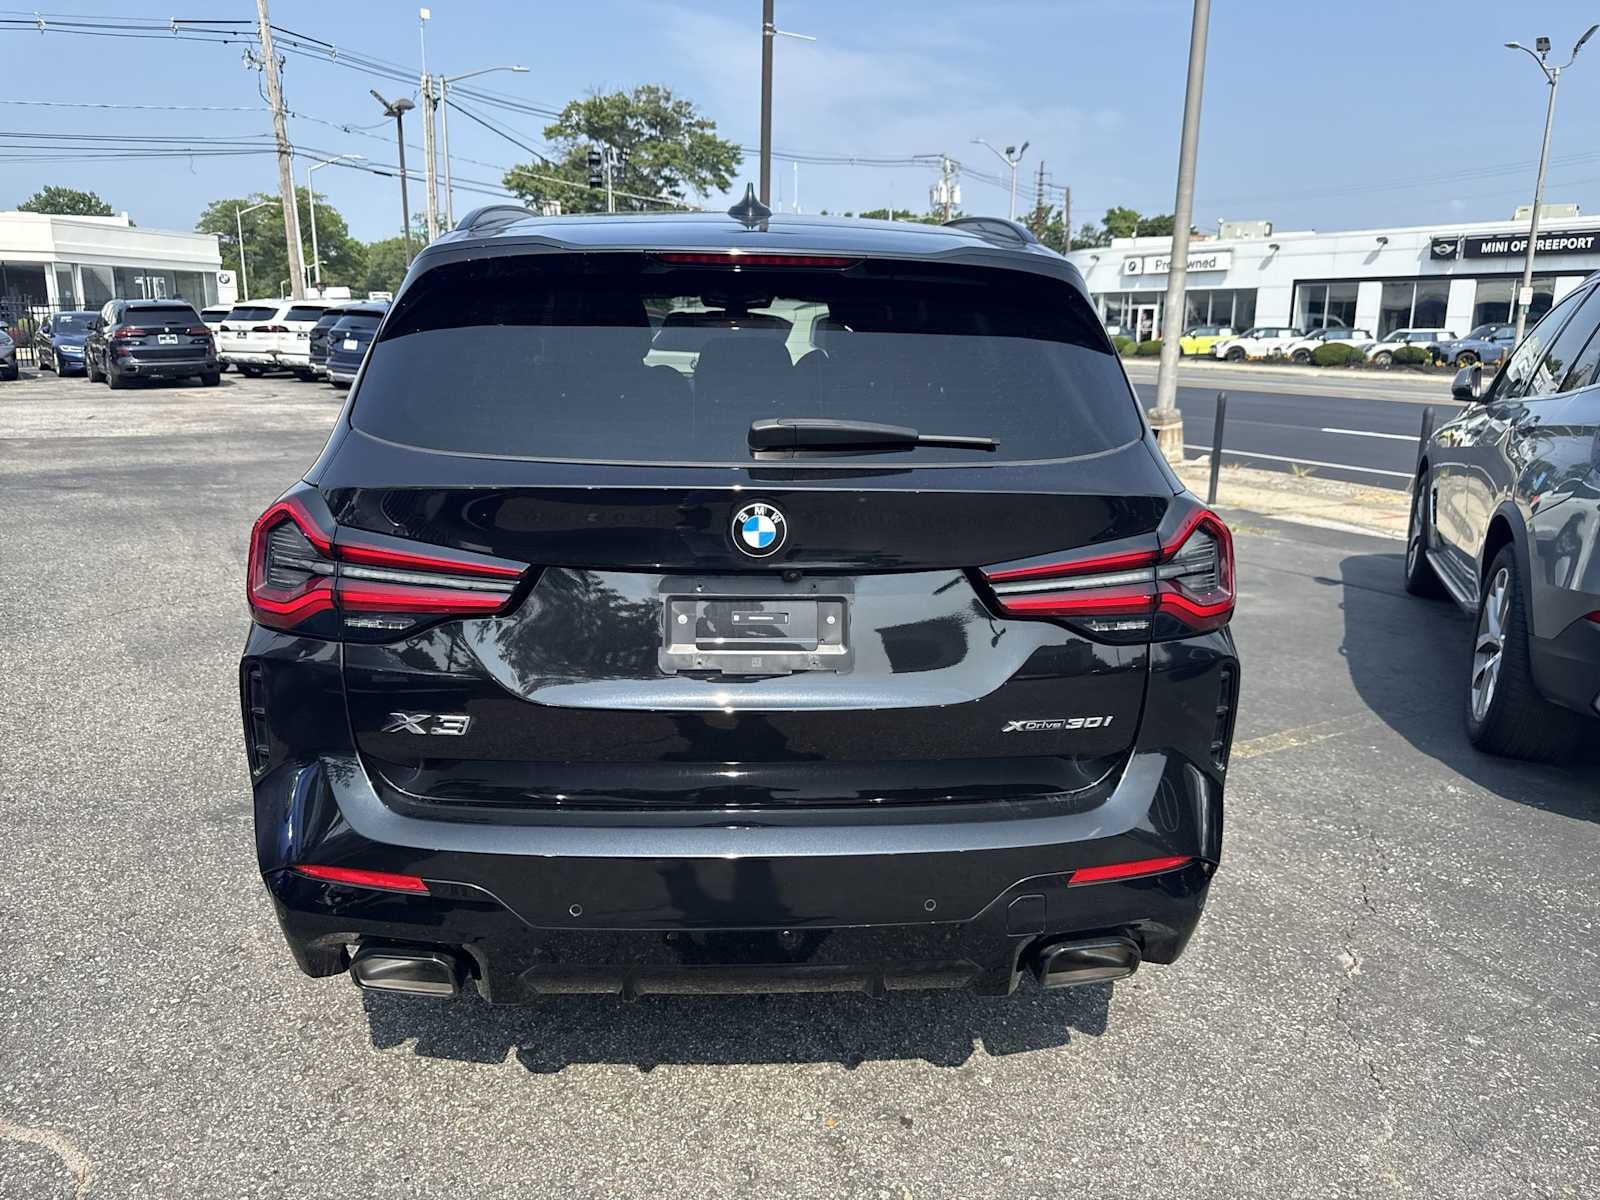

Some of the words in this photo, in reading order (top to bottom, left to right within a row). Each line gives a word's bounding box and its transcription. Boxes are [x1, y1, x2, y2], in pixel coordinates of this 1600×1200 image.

[1481, 241, 1508, 253] MINI
[1511, 240, 1528, 252] OF
[1535, 237, 1595, 251] REEPORT
[738, 505, 782, 524] BMW
[381, 712, 470, 736] X3
